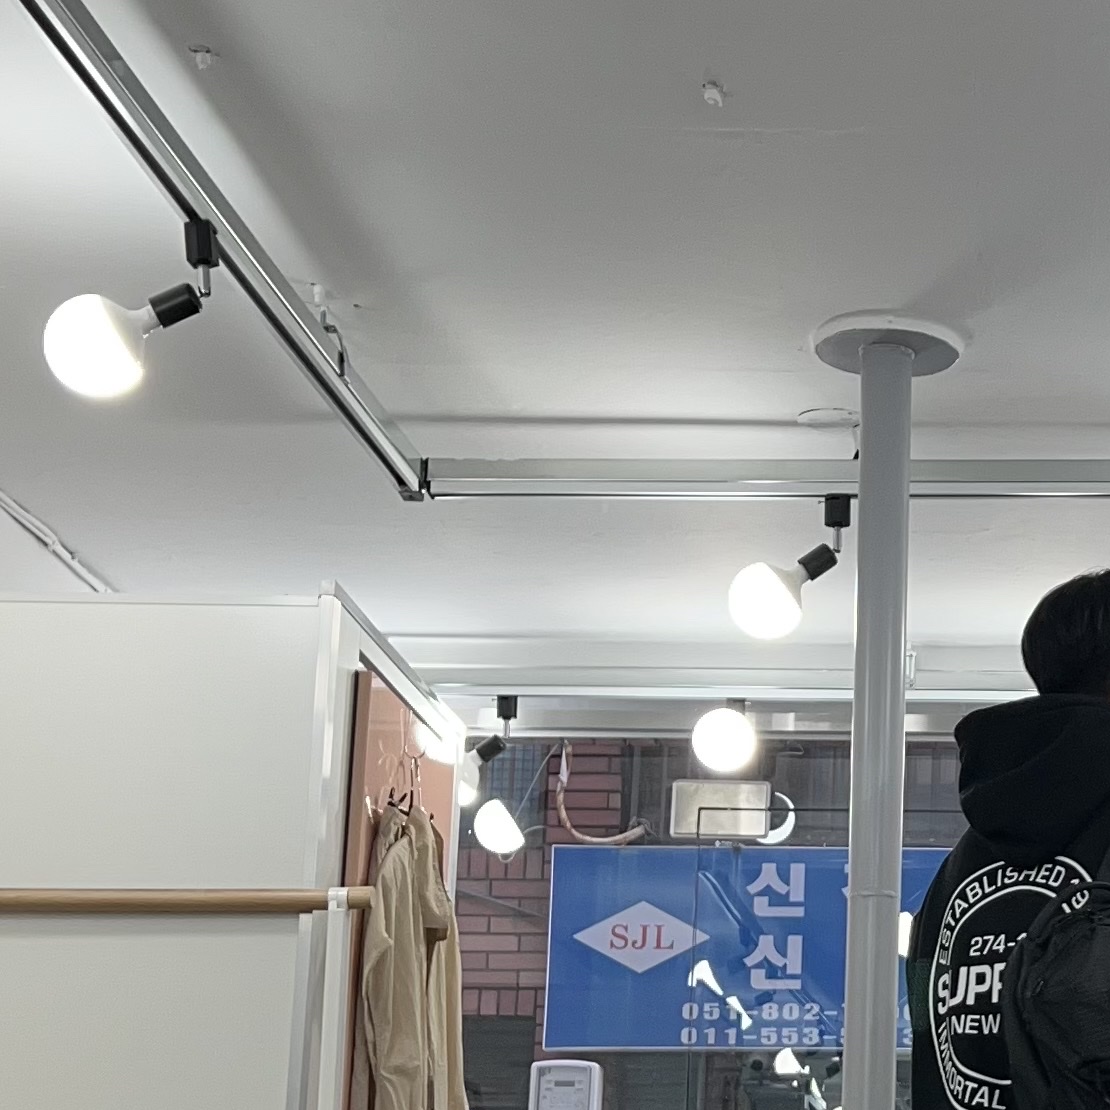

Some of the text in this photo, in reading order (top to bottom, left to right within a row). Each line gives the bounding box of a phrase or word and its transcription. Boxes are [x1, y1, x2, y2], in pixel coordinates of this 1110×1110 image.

[609, 923, 675, 951] SJL
[938, 863, 1066, 966] ESTABLISHED
[950, 1013, 1001, 1035] NEW
[938, 1020, 1007, 1110] IMMORTAL
